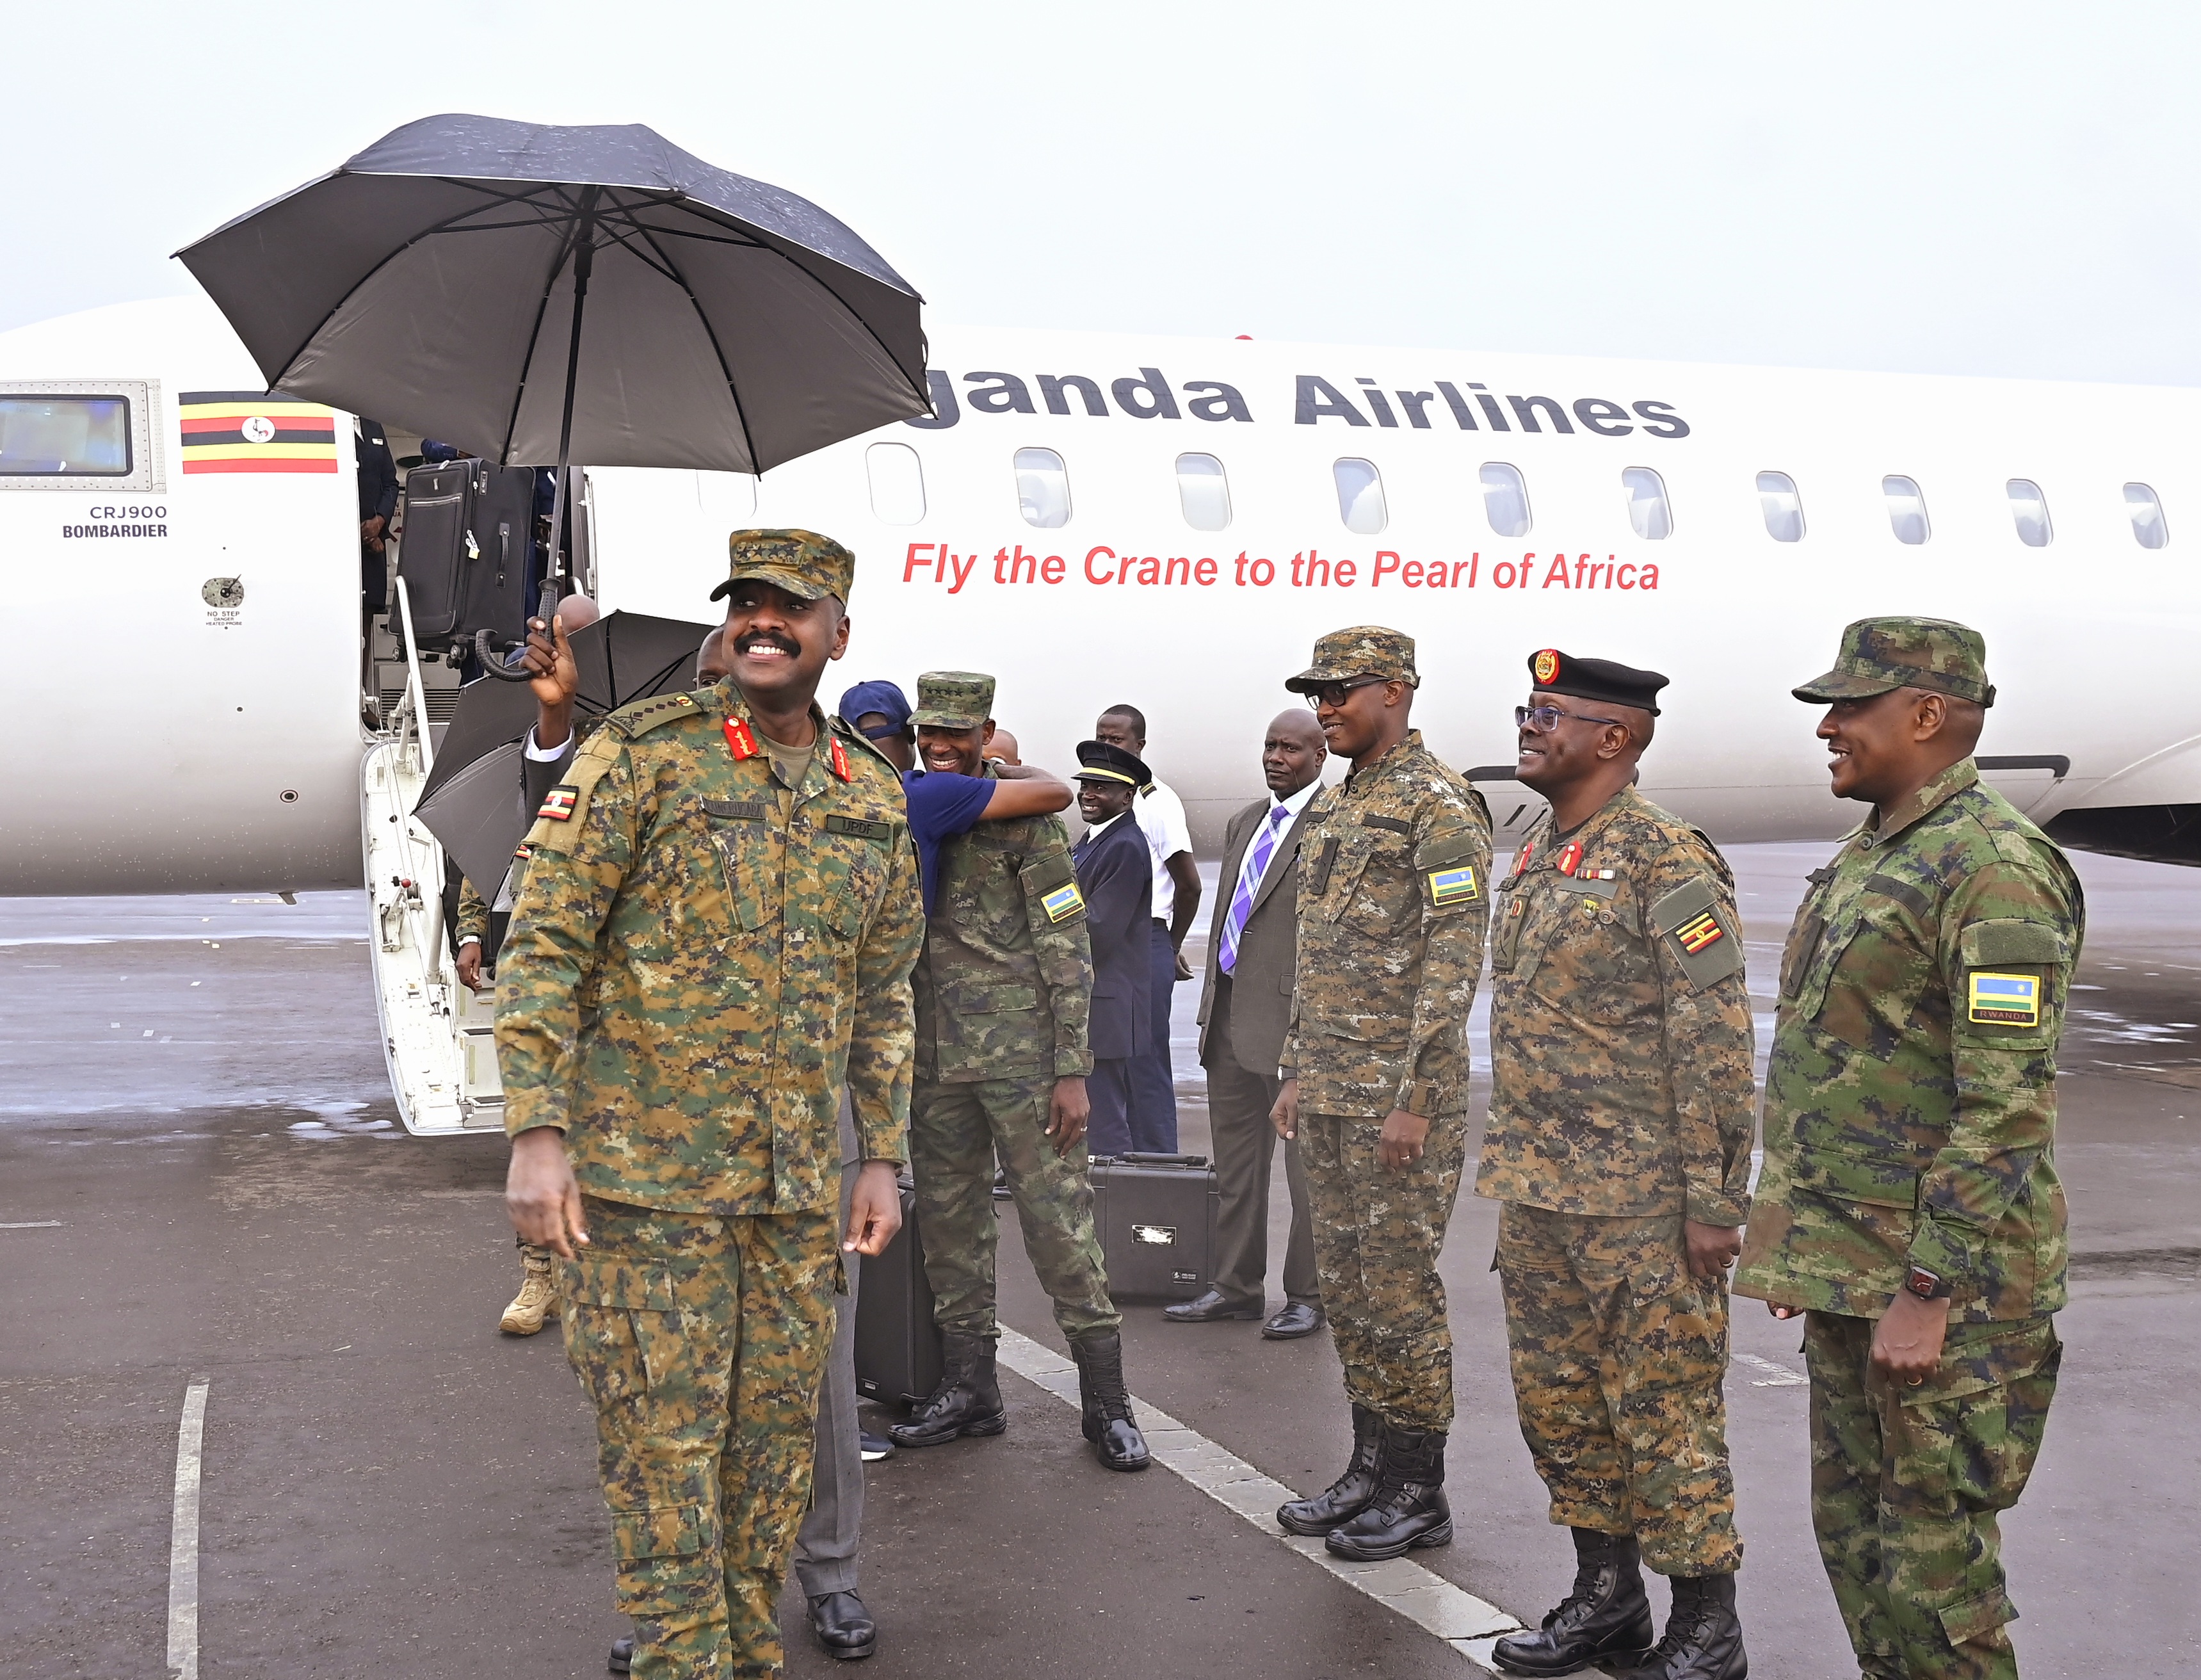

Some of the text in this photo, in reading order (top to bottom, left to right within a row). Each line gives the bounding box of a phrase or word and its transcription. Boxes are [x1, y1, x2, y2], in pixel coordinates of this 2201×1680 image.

[901, 367, 1690, 439] ganda Airlines
[90, 506, 167, 519] CRJ900
[63, 524, 168, 538] BOMBARDIER
[903, 543, 1659, 595] Fly the Crane to the Pearl of Africa
[842, 820, 874, 834] UPDF
[1979, 1010, 2027, 1020] RWANDA
